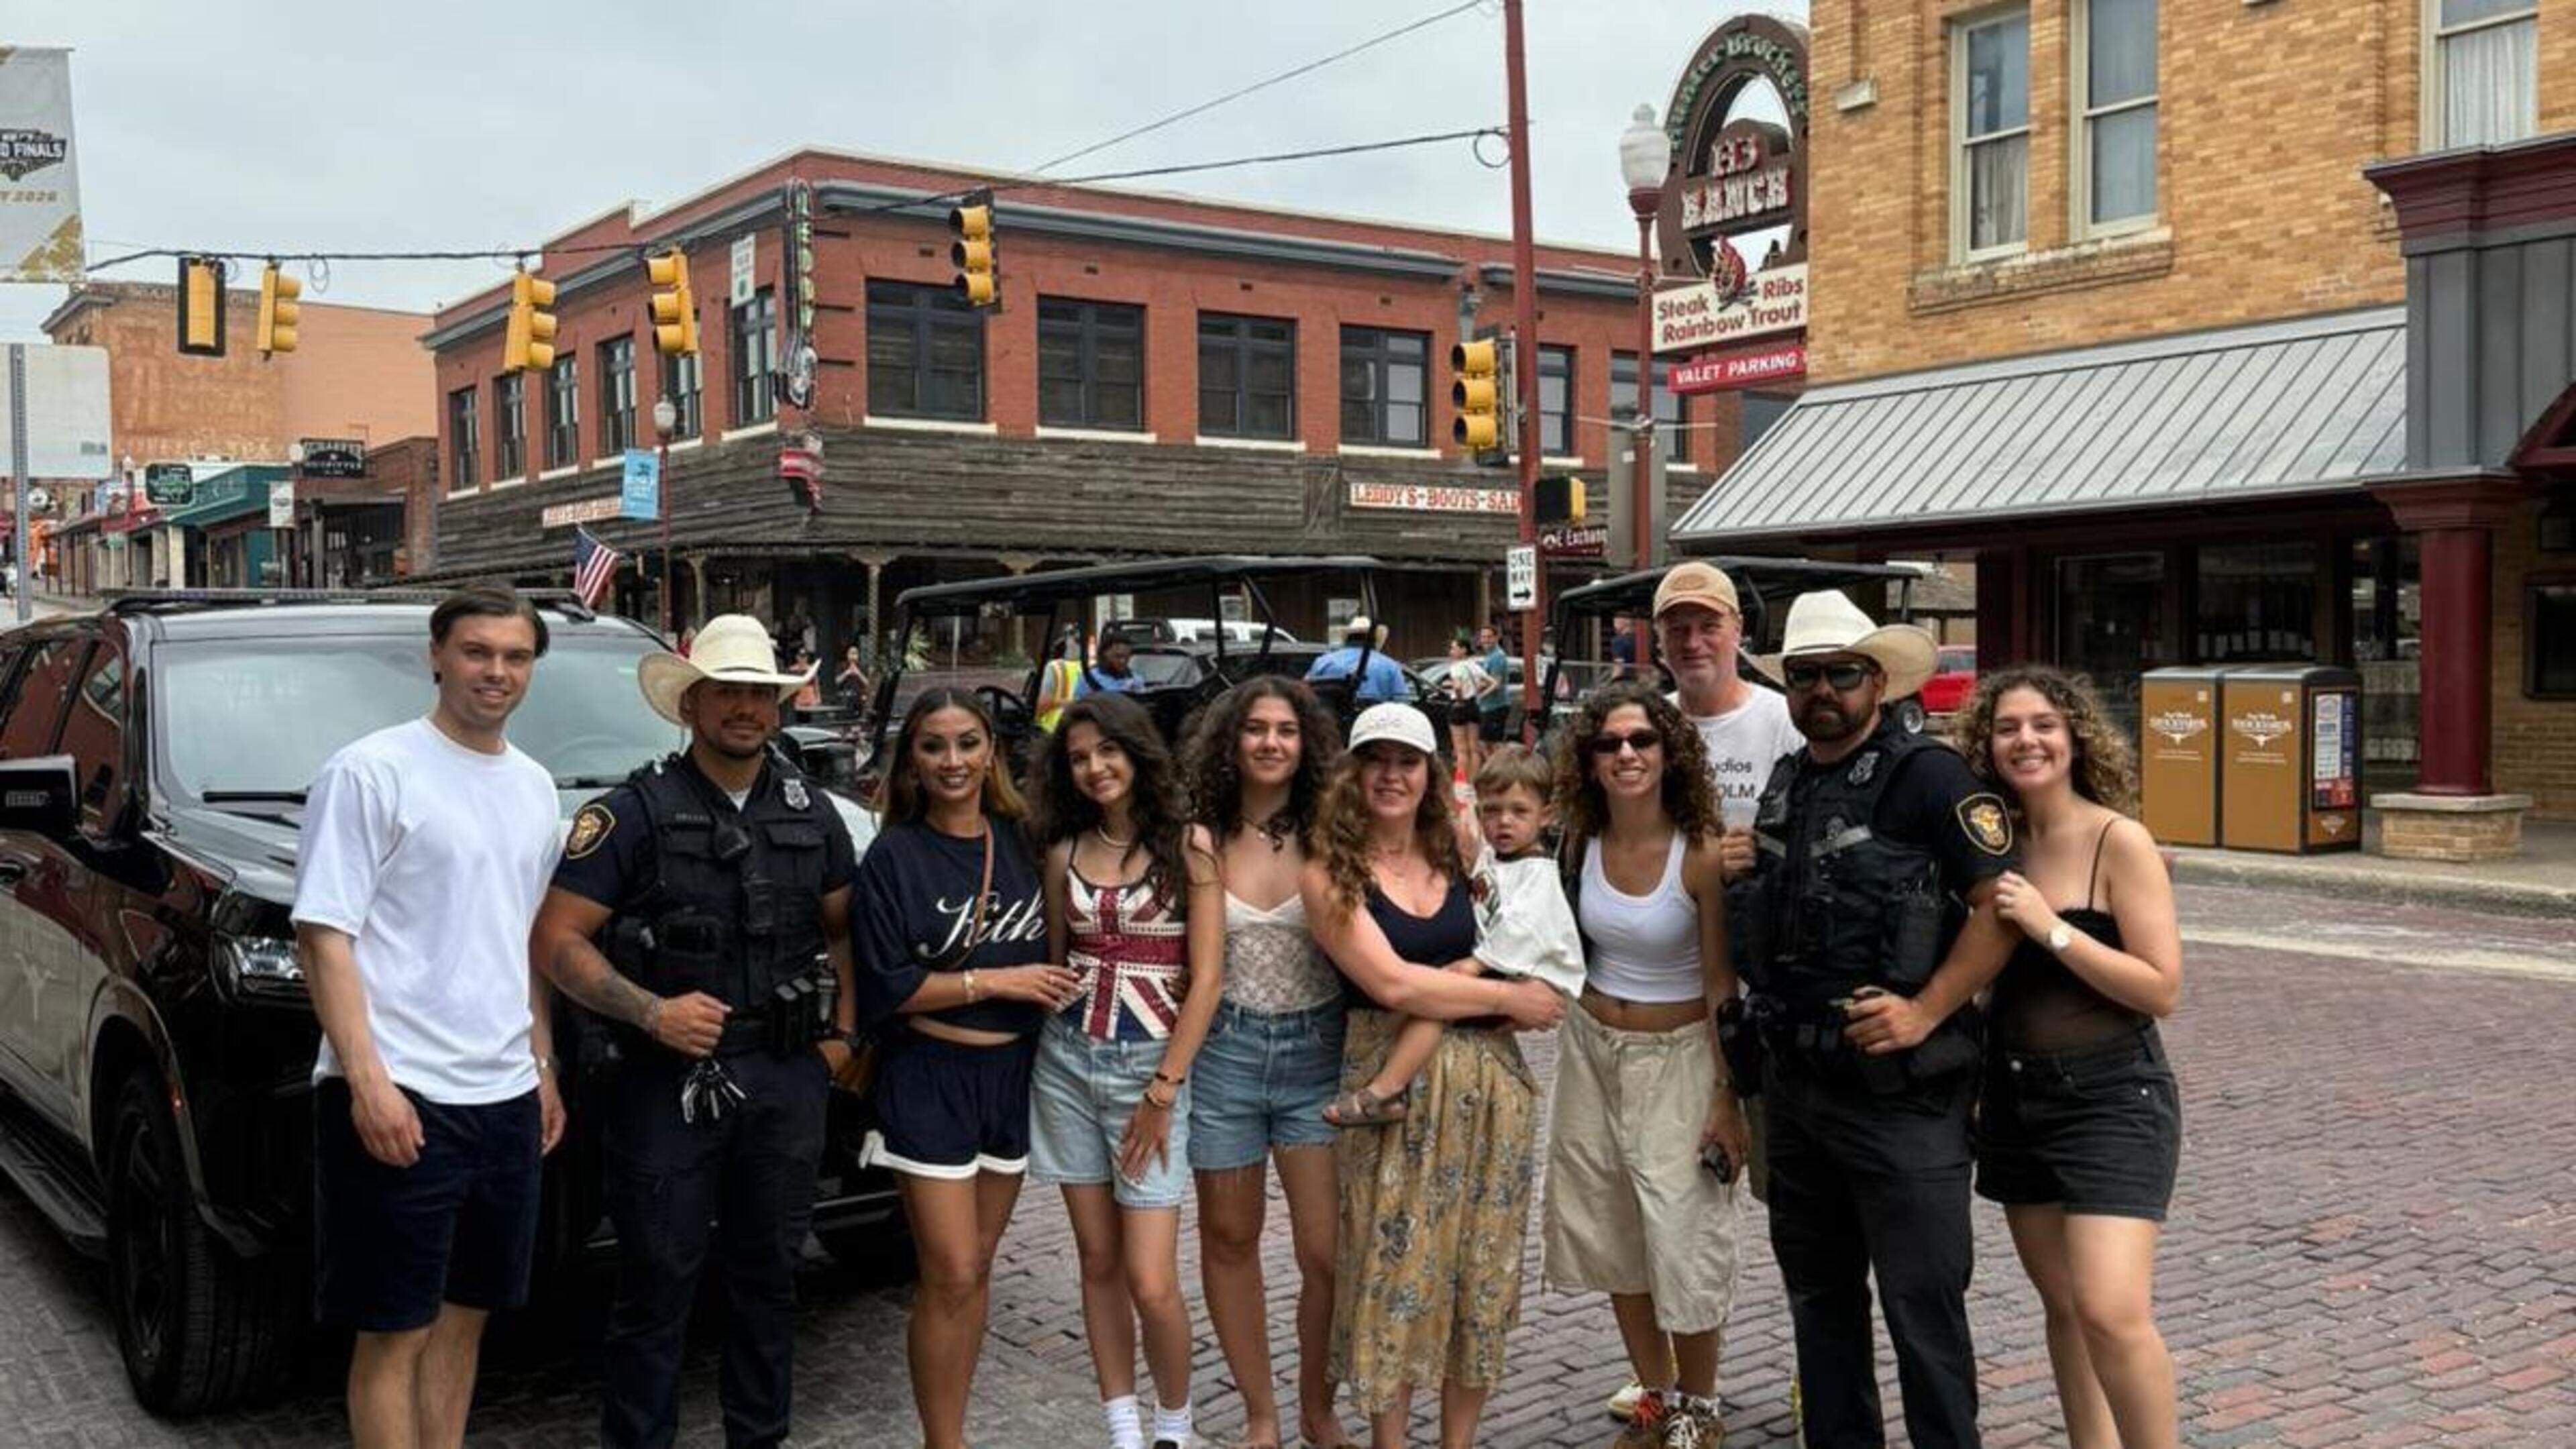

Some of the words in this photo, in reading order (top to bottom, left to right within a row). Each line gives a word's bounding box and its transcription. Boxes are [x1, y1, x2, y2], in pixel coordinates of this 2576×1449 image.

[14, 142, 63, 157] FINALS
[1681, 166, 1788, 230] RANCH
[1658, 293, 1710, 321] Steak
[1763, 276, 1804, 301] Ribs
[1662, 313, 1746, 344] Rainbow
[1750, 300, 1801, 327] Trout
[1676, 364, 1722, 384] VALET
[1727, 351, 1798, 378] PARKING
[1511, 551, 1532, 568] ONE
[1511, 570, 1533, 585] WAY
[918, 887, 1047, 958] Kith
